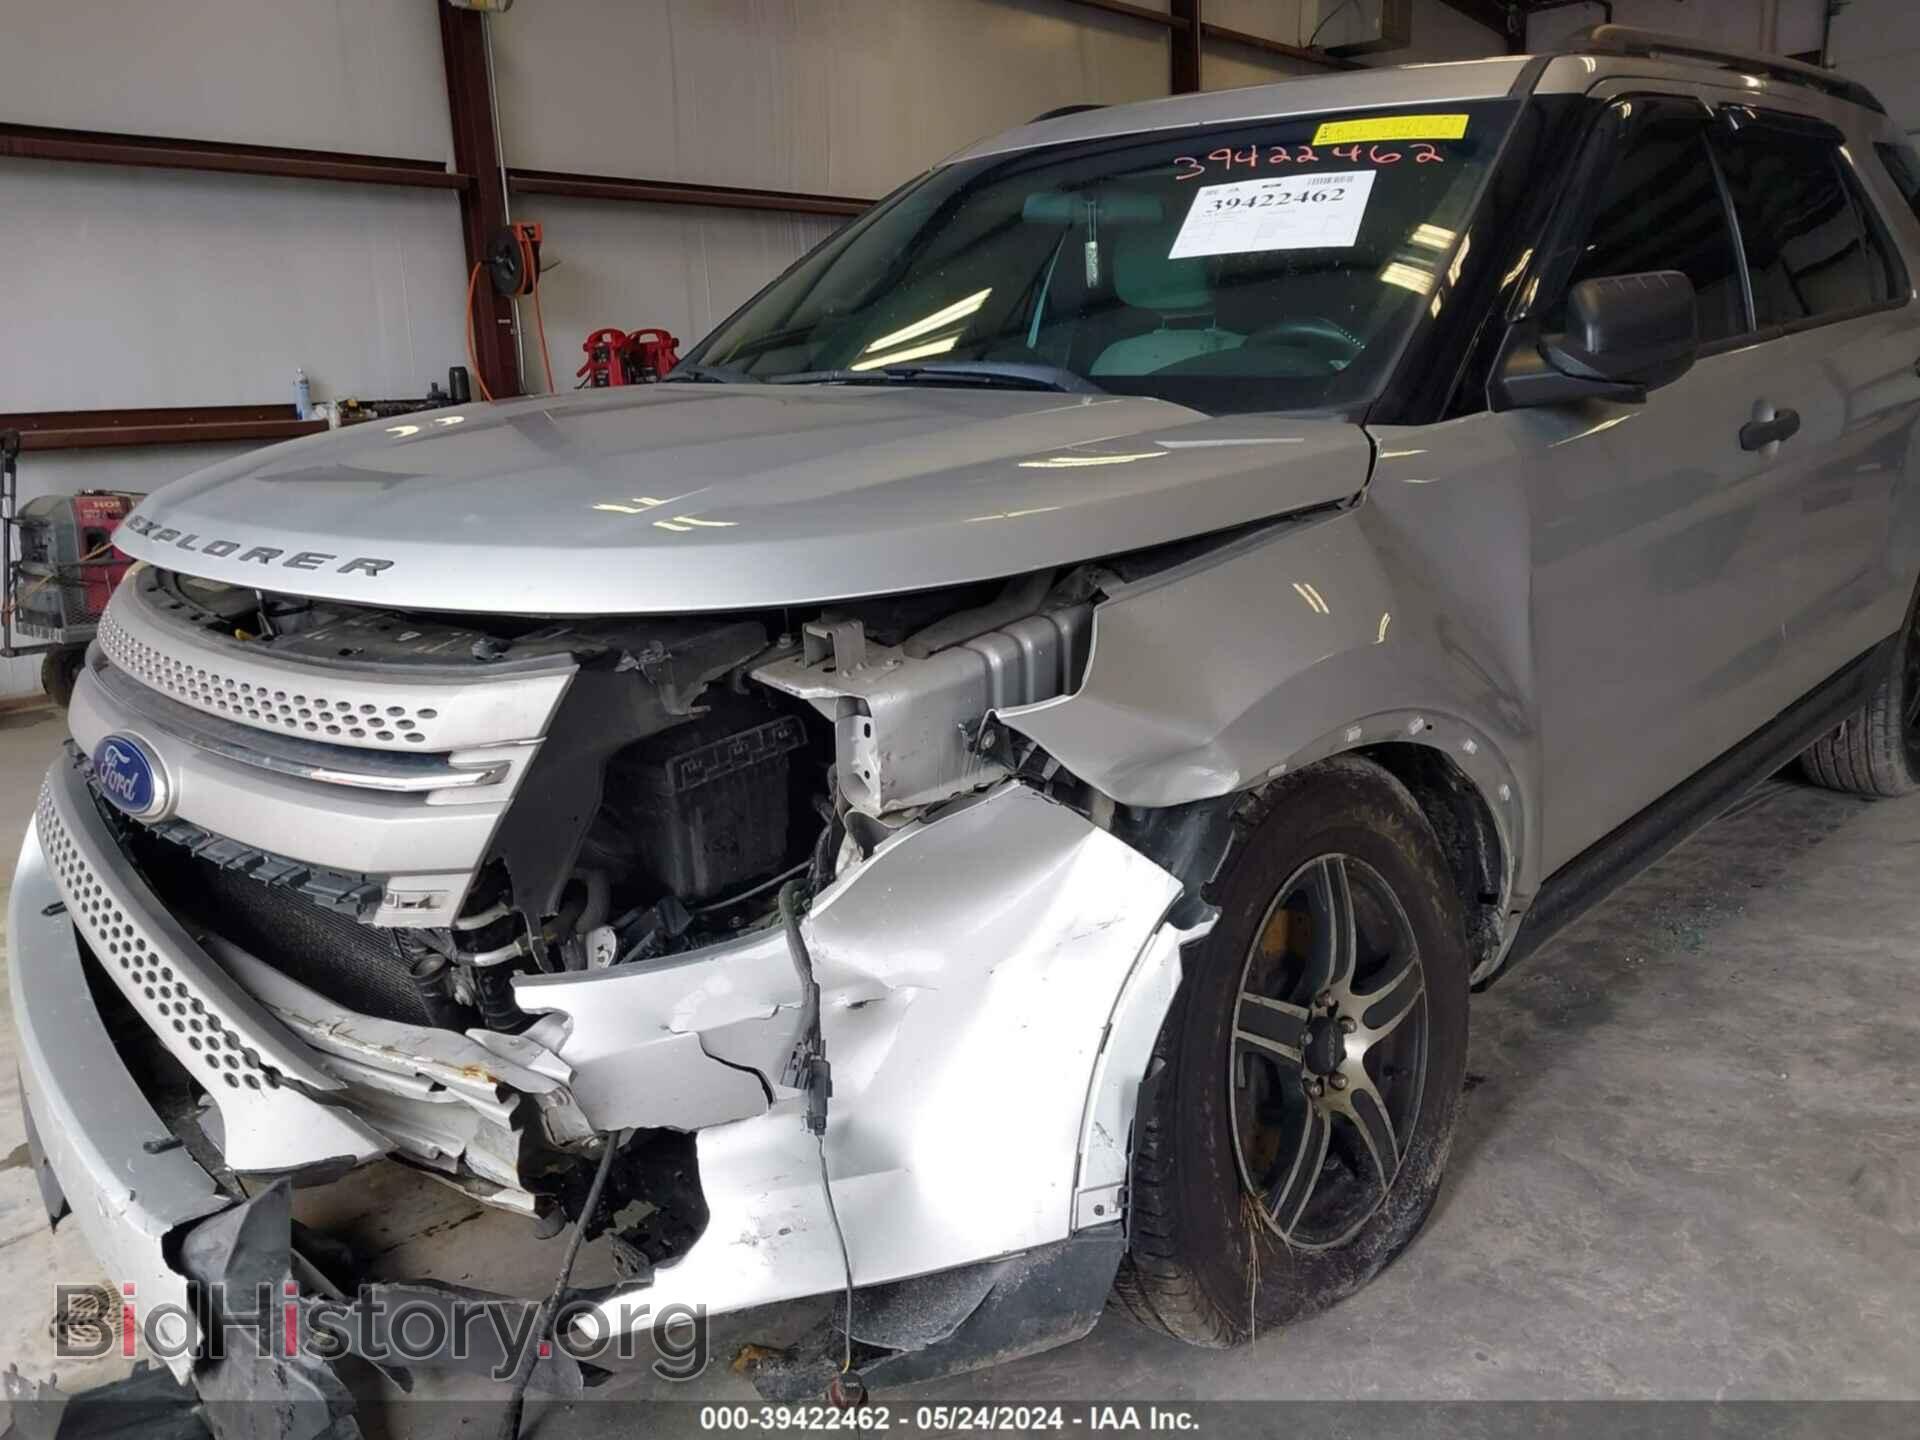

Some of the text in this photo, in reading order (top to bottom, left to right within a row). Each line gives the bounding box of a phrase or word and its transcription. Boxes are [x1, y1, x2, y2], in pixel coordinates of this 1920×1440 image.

[1174, 144, 1444, 180] 39422462
[1207, 187, 1345, 212] 39422462
[126, 515, 395, 577] EXPLORER
[100, 745, 139, 801] Ford
